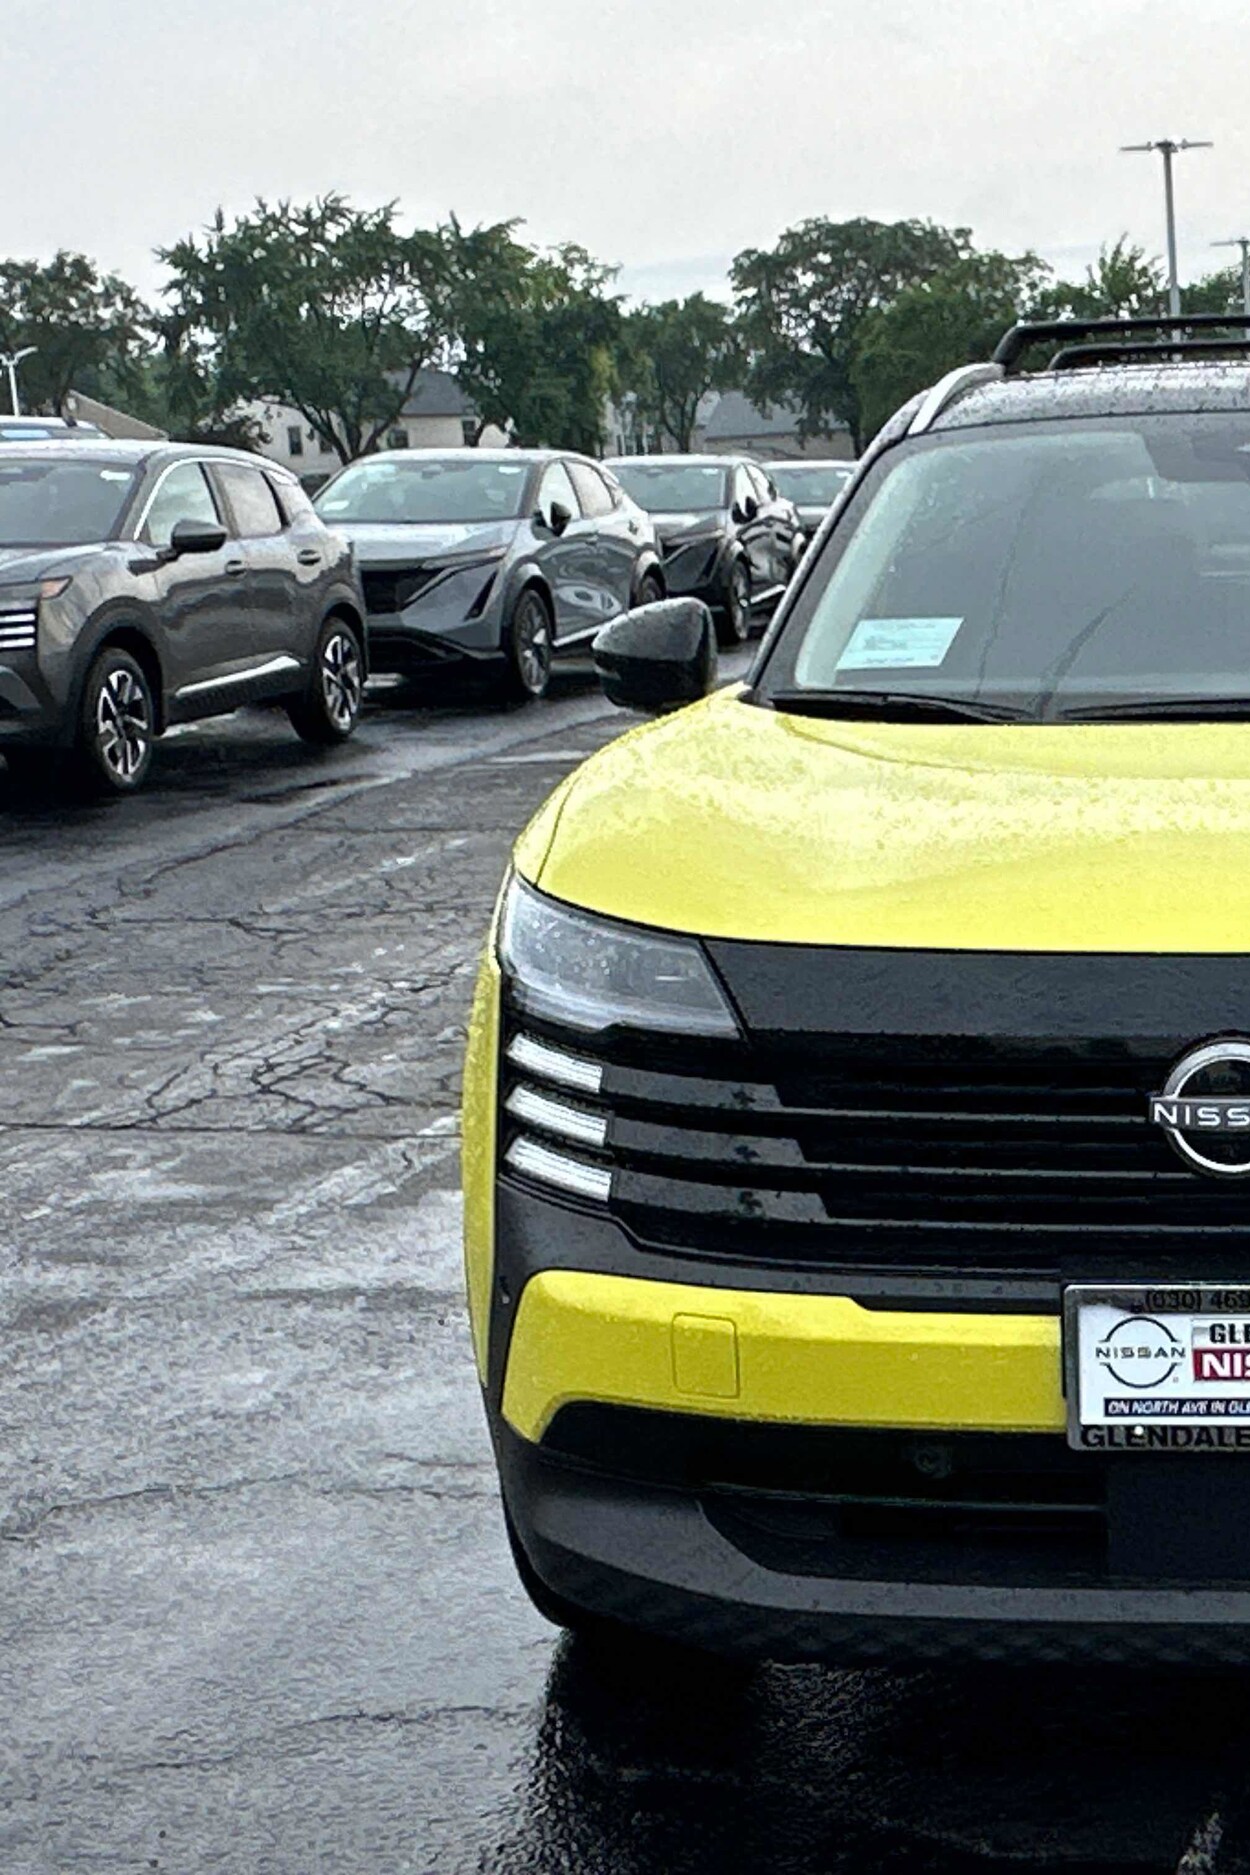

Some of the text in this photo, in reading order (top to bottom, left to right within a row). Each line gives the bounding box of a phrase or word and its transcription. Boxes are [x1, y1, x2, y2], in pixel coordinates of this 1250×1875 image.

[1095, 1345, 1186, 1359] NISSAN
[1108, 1399, 1130, 1414] ON
[1132, 1399, 1178, 1414] NORTH
[1181, 1399, 1207, 1414] AVE
[1210, 1399, 1225, 1414] IN
